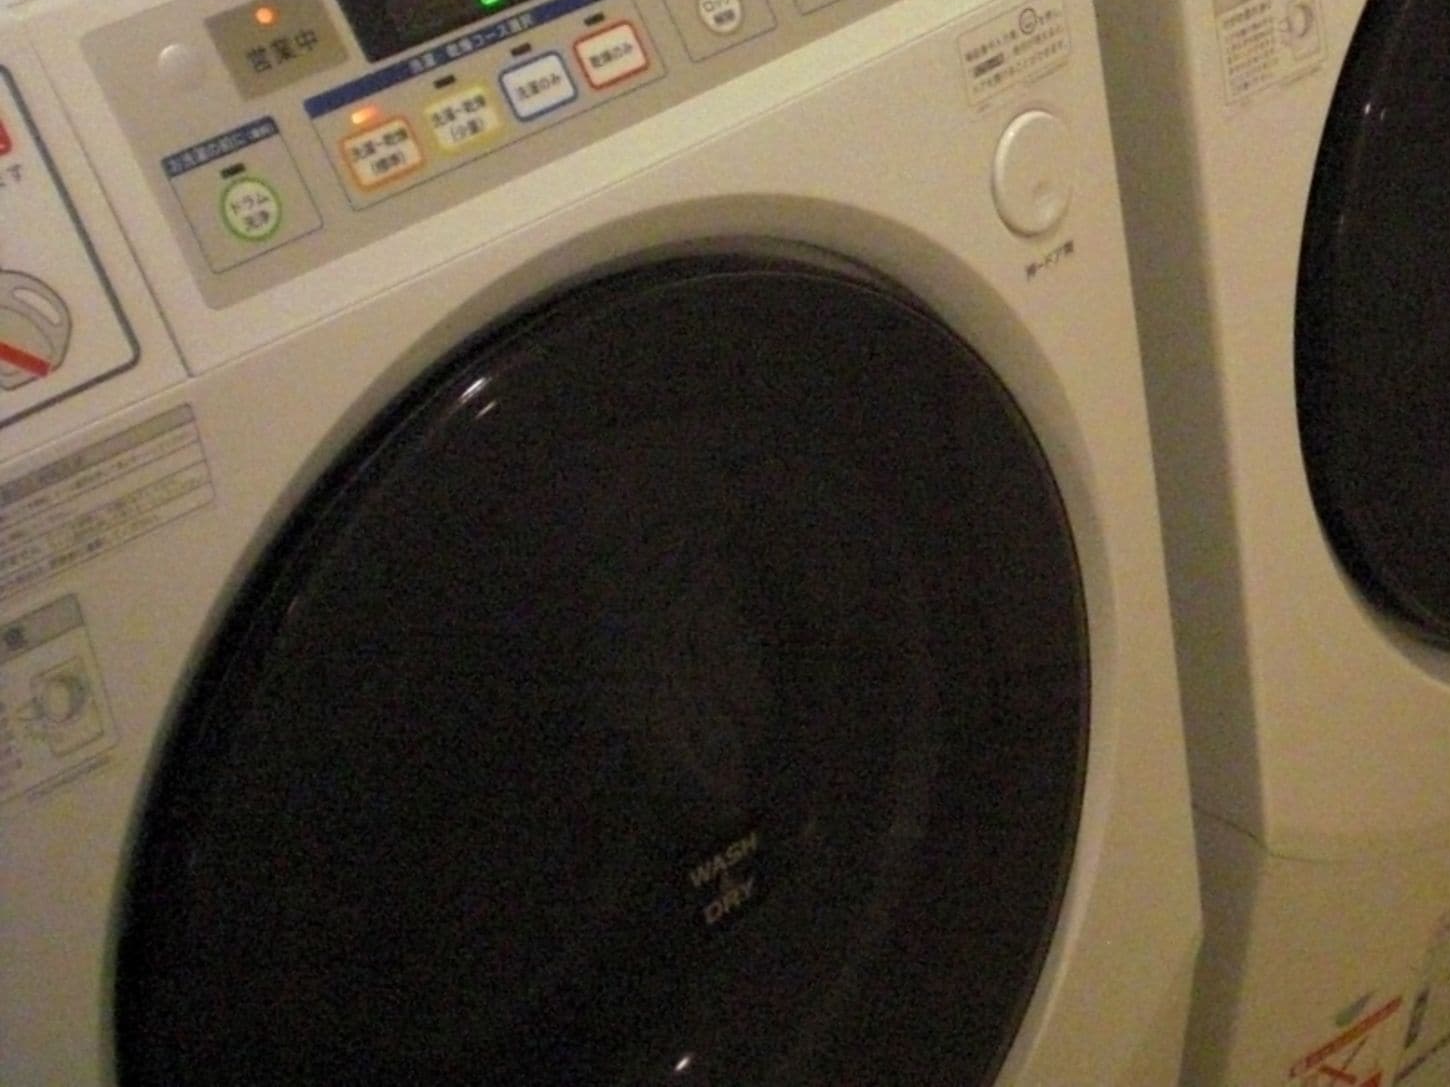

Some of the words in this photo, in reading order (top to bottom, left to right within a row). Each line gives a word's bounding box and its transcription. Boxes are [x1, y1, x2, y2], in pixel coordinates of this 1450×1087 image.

[245, 27, 320, 76] 営業中
[513, 70, 564, 102] 洗濯のみ
[227, 188, 272, 218] ドラム
